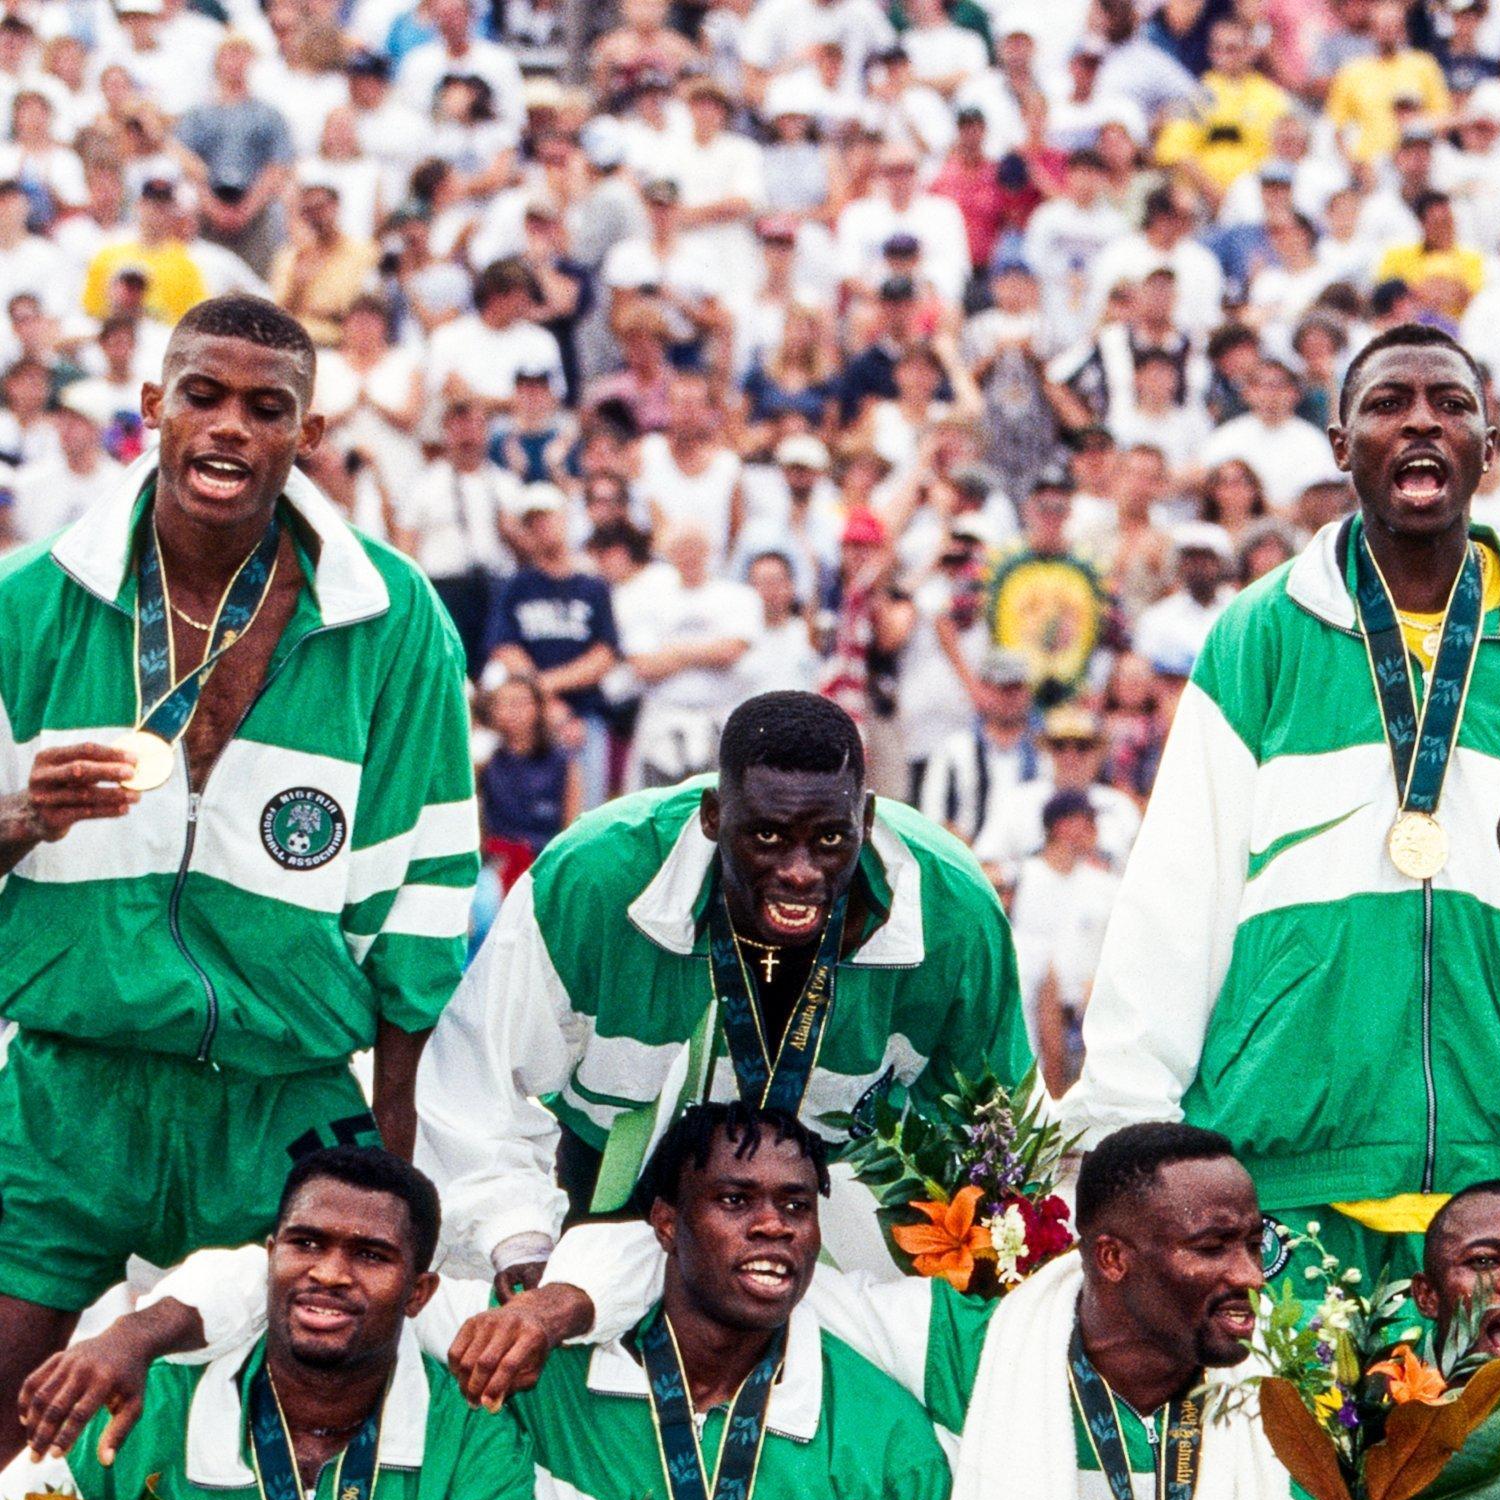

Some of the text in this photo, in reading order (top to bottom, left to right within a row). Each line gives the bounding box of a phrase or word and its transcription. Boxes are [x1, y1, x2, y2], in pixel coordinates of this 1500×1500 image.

[279, 790, 339, 814] NIGERIA
[263, 807, 344, 867] FOOTBALL ASSOCIATION
[790, 1003, 817, 1051] Atlanta
